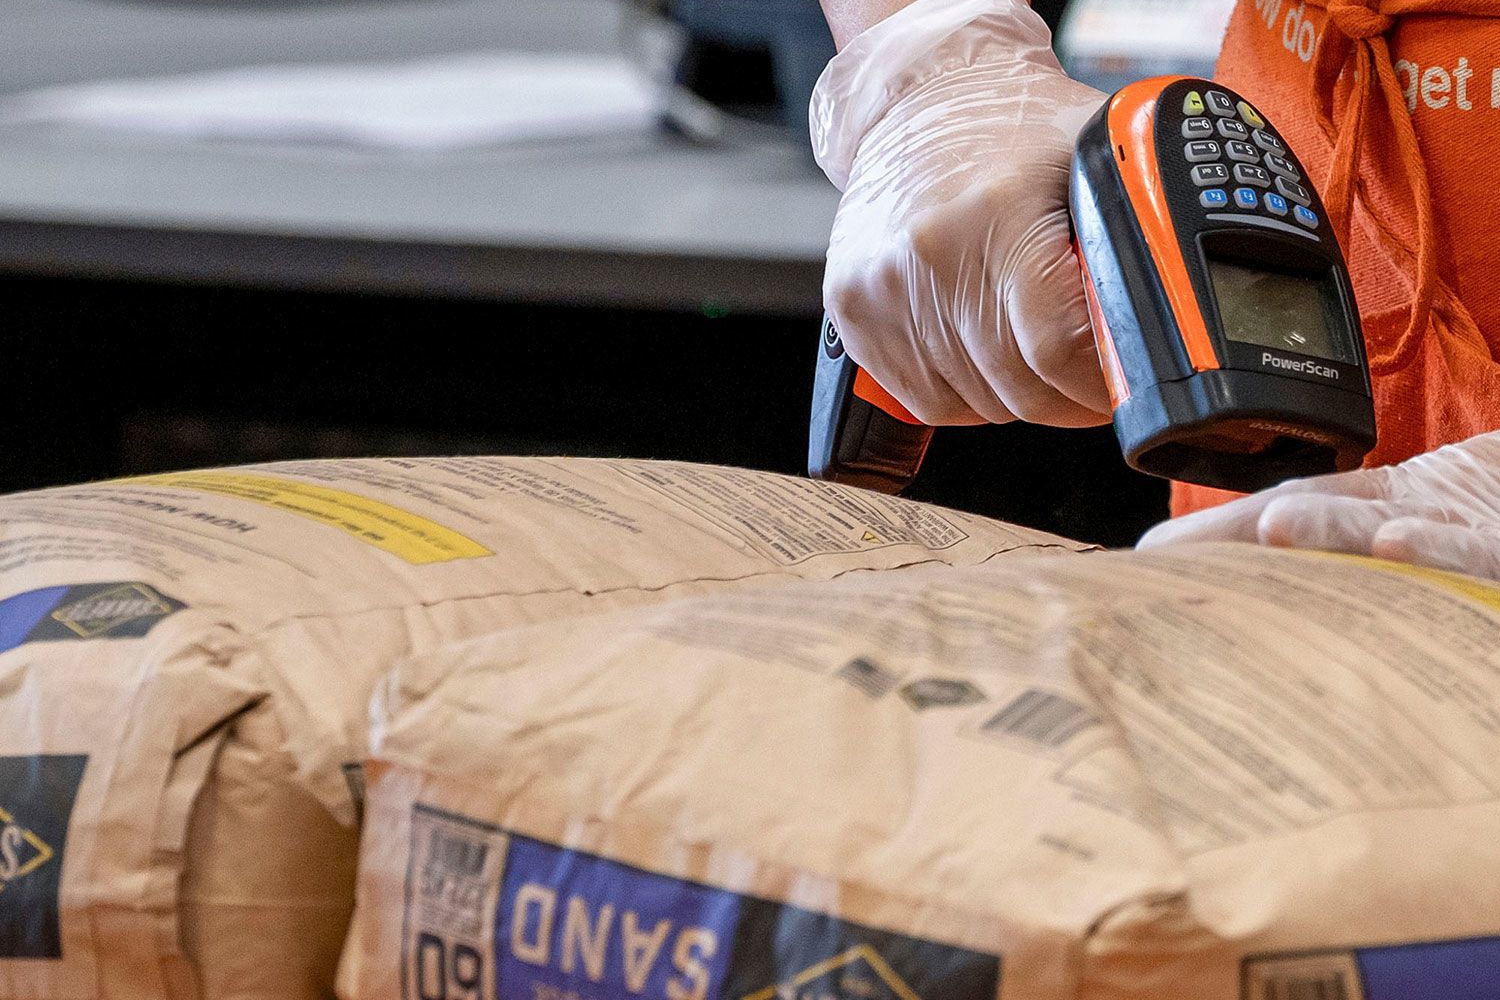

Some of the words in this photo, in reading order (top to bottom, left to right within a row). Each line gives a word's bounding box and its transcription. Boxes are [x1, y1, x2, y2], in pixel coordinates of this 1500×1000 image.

[1395, 56, 1472, 114] get
[1221, 97, 1229, 107] 0
[1201, 120, 1209, 129] 9
[1236, 123, 1244, 132] 8
[1208, 143, 1217, 152] 6
[1245, 145, 1253, 155] 5
[1215, 166, 1224, 176] 3
[1255, 168, 1264, 179] 2
[1261, 352, 1339, 380] PowerScan
[510, 882, 719, 1000] SAND
